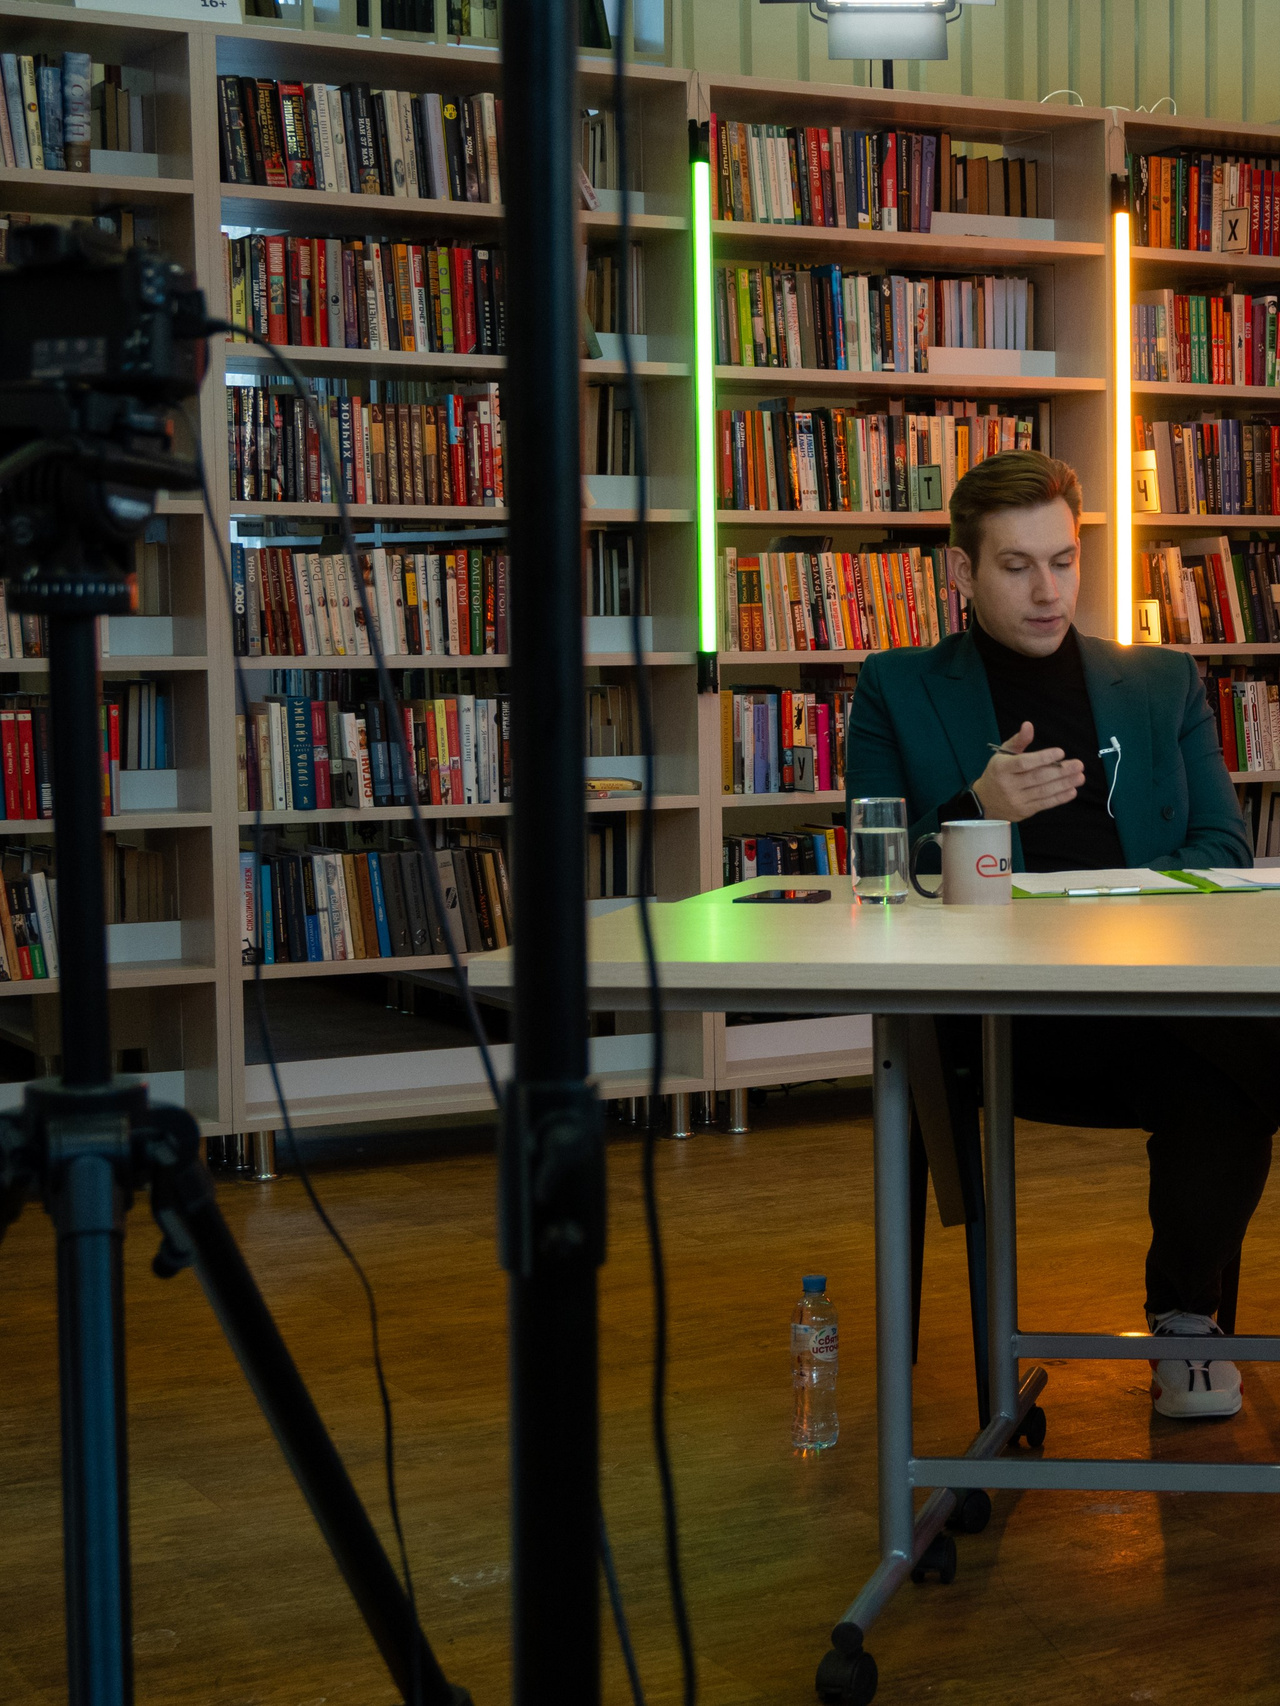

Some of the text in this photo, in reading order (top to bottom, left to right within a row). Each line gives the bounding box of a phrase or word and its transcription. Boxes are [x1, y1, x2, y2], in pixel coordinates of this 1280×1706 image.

[71, 84, 84, 137] СЫН
[316, 85, 327, 118] ПЕТРОВ
[360, 137, 367, 146] 37
[365, 118, 373, 147] БРАЧНАЯ
[721, 127, 729, 176] Елтышевы
[269, 243, 283, 273] ПОЛЯКОВ
[300, 246, 311, 275] ПОЛЯКОВ
[260, 297, 268, 334] ПОКРЫШКИН
[368, 301, 378, 341] ПРАТЧЕТТ
[341, 402, 351, 457] ХИЧКОК
[311, 558, 319, 581] Рой
[324, 560, 332, 575] Рой
[336, 558, 346, 581] Рой
[392, 559, 401, 582] Рой
[432, 559, 441, 581] Рой
[814, 565, 822, 596] ТРАУБ
[459, 584, 468, 605] РОЙ
[472, 558, 482, 613] ОЛЕГ РОЙ
[857, 582, 865, 608] МАША
[742, 612, 750, 647] МОСКИТ
[754, 612, 762, 647] МОСКИТ
[502, 701, 510, 740] НАПРЯЖЕНИЕ
[363, 756, 374, 798] САГАН
[244, 867, 253, 931] СОКОЛИНЫЙ РУБЕЖ
[331, 894, 341, 934] ЕСЛИ БЫ ТЫ
[479, 894, 489, 930] ХИРУРГ
